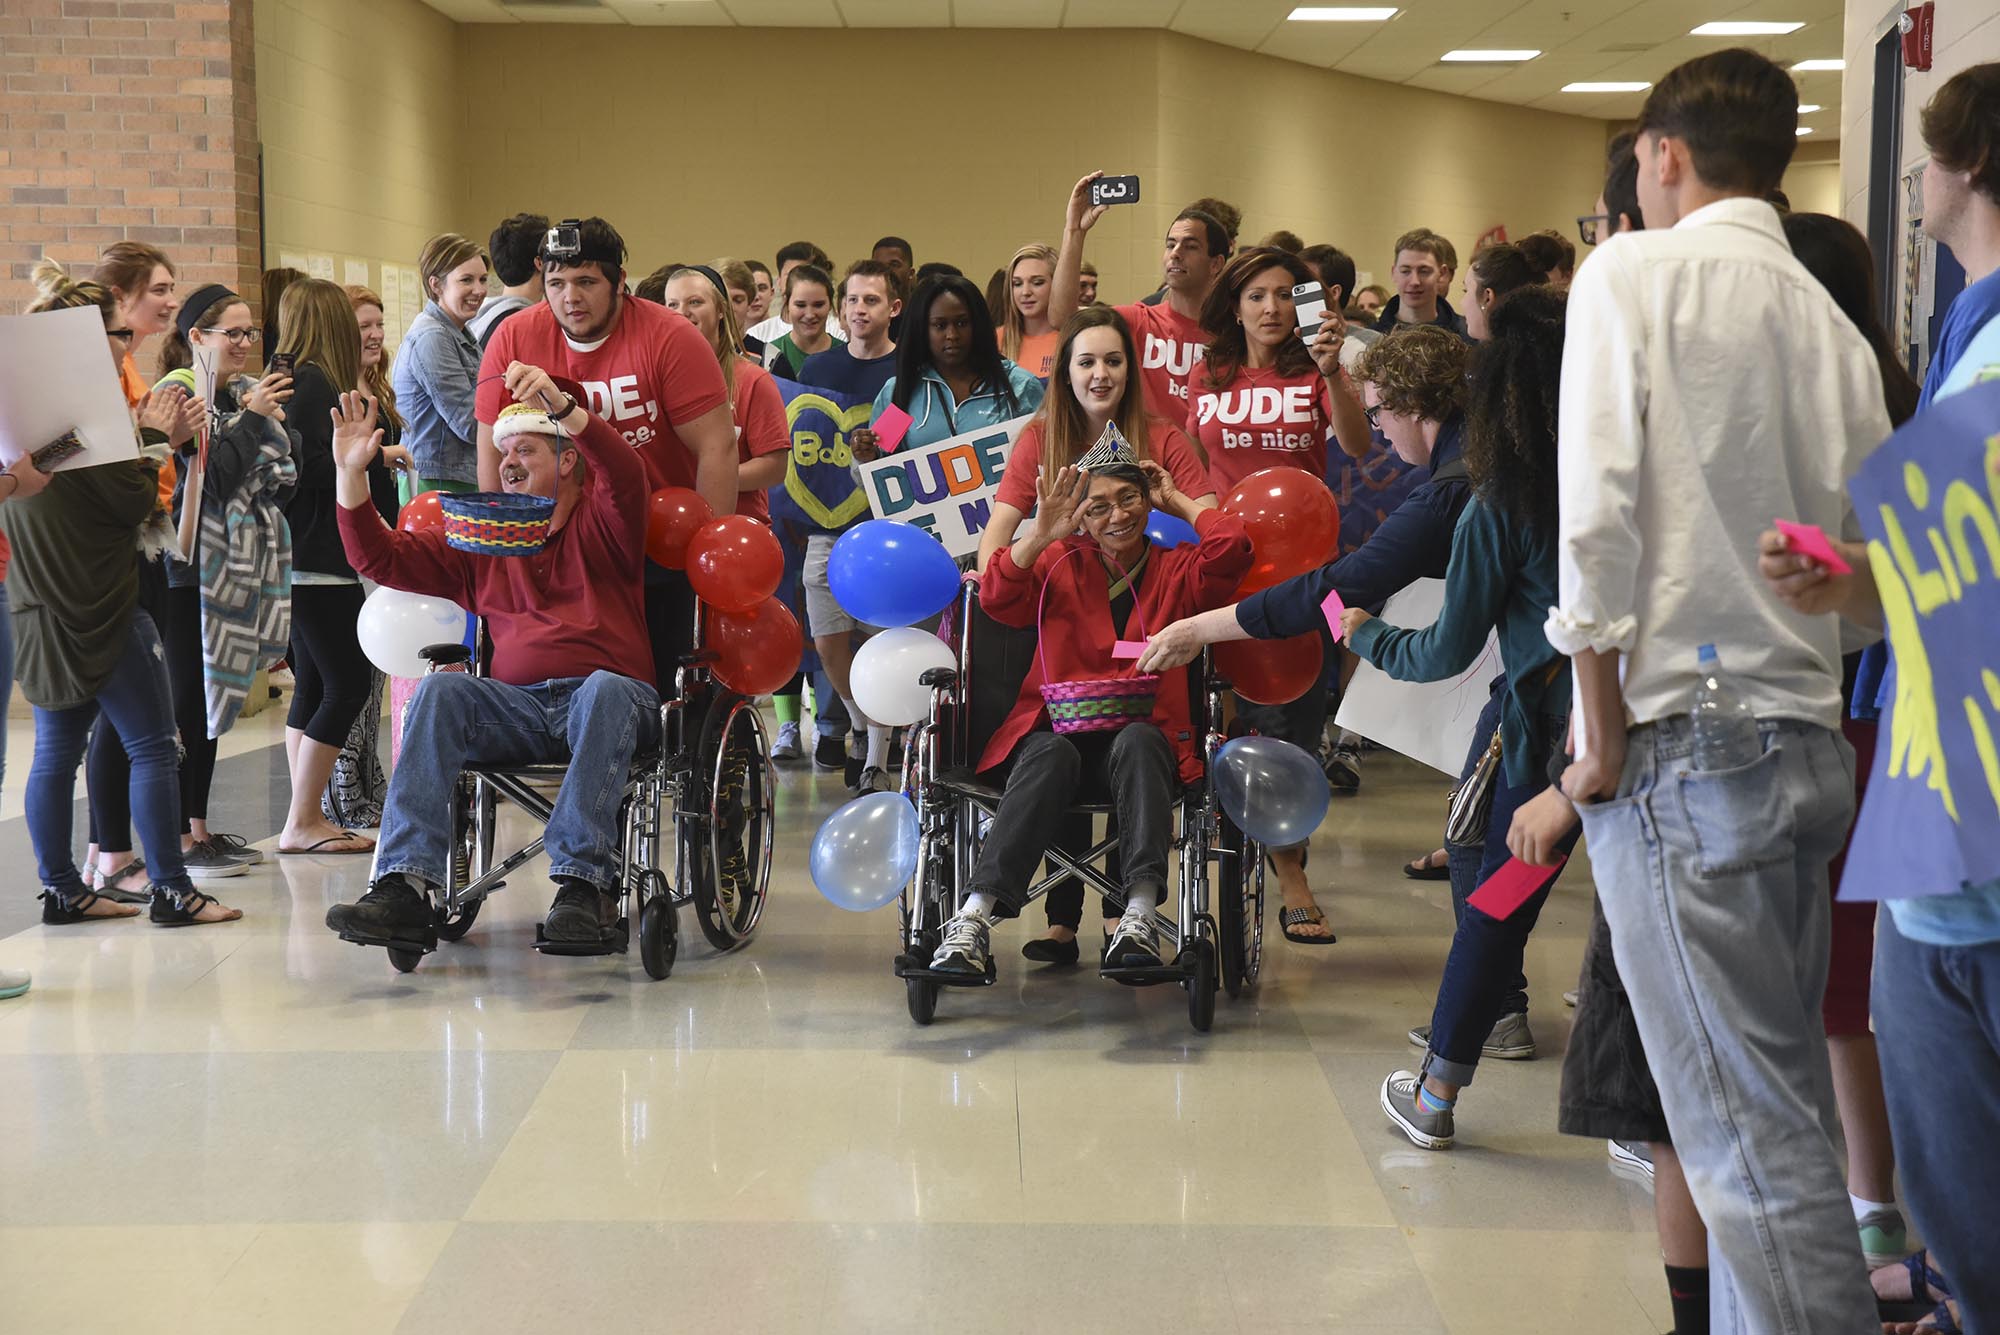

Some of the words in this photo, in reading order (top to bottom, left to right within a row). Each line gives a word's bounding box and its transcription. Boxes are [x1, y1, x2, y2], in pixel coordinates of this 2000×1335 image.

[1923, 18, 1931, 51] FIRE
[578, 374, 658, 423] DE,
[793, 430, 851, 468] Bob
[1222, 428, 1253, 449] be
[871, 431, 1009, 517] DUDE
[1879, 436, 2000, 617] Lin
